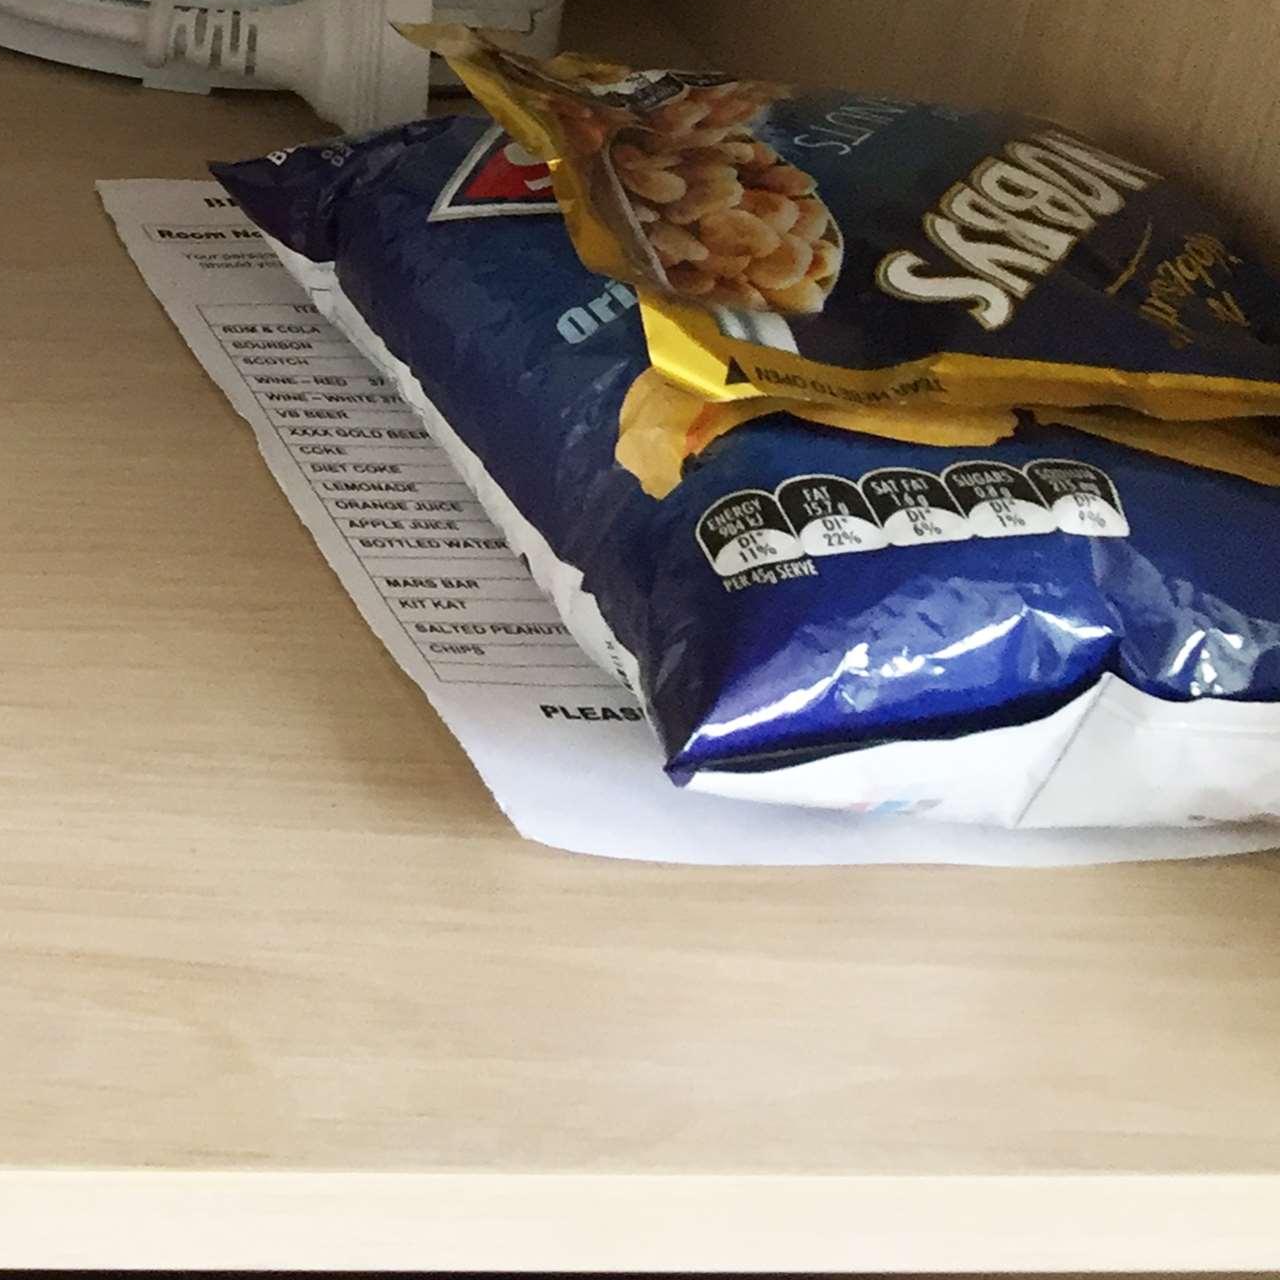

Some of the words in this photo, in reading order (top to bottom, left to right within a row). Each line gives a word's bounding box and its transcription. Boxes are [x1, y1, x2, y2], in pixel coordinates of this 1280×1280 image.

[156, 229, 224, 240] Room
[276, 325, 322, 335] COLA
[231, 340, 313, 351] BOURBON
[242, 356, 310, 366] SCOTCH
[254, 375, 298, 386] WINE
[313, 375, 349, 387] RED
[265, 392, 308, 402] WINE
[321, 394, 378, 404] WHITE
[276, 409, 300, 419] VB
[304, 409, 350, 420] BEER
[290, 427, 335, 437] XXXX
[336, 428, 383, 439] GOLD
[386, 429, 431, 440] BEER
[298, 445, 349, 456] COKE
[309, 463, 352, 473] DIET
[352, 464, 403, 474] COKE
[952, 470, 1015, 488] SUGARS
[321, 481, 419, 493] LEMONADE
[870, 479, 901, 495] SAT
[901, 478, 929, 493] FAT
[801, 485, 832, 502] FAT
[335, 500, 410, 512] ORANGE
[413, 500, 465, 512] JUICE
[705, 498, 764, 531] ENERGY
[996, 513, 1026, 528] 1%
[347, 518, 405, 530] APPLE
[409, 519, 461, 531] JUICE
[912, 522, 942, 537] 6%
[358, 537, 442, 549] BOTTLED
[443, 538, 509, 550] WATER
[823, 531, 862, 548] 22%
[722, 572, 752, 593] PER
[751, 568, 779, 586] 45g
[778, 558, 820, 581] SERVE
[384, 578, 438, 589] MARS
[440, 578, 481, 590] BAR
[397, 598, 428, 610] KIT
[431, 598, 468, 611] KAT
[413, 622, 488, 636] SALTED
[428, 642, 486, 656] CHIPS
[540, 704, 644, 723] PLEAS
